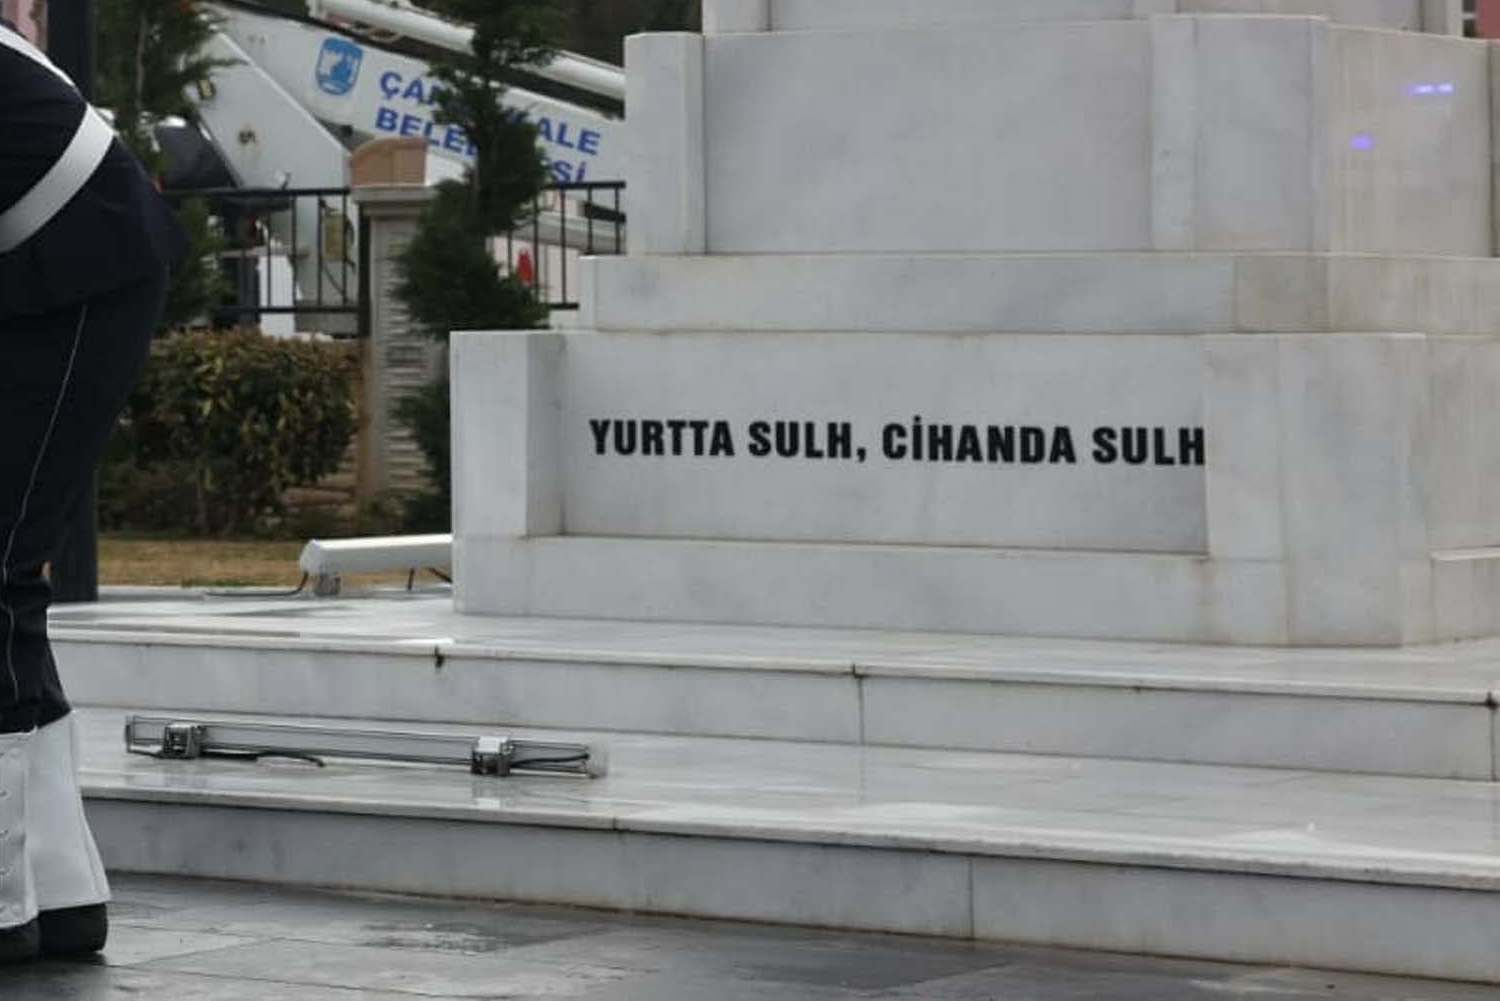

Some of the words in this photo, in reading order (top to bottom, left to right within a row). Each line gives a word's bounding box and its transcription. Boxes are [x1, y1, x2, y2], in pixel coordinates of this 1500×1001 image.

[589, 419, 735, 457] YURTTA
[748, 421, 867, 463] SULH,
[882, 415, 1077, 464] CİHANDA
[1092, 426, 1205, 466] SULH
